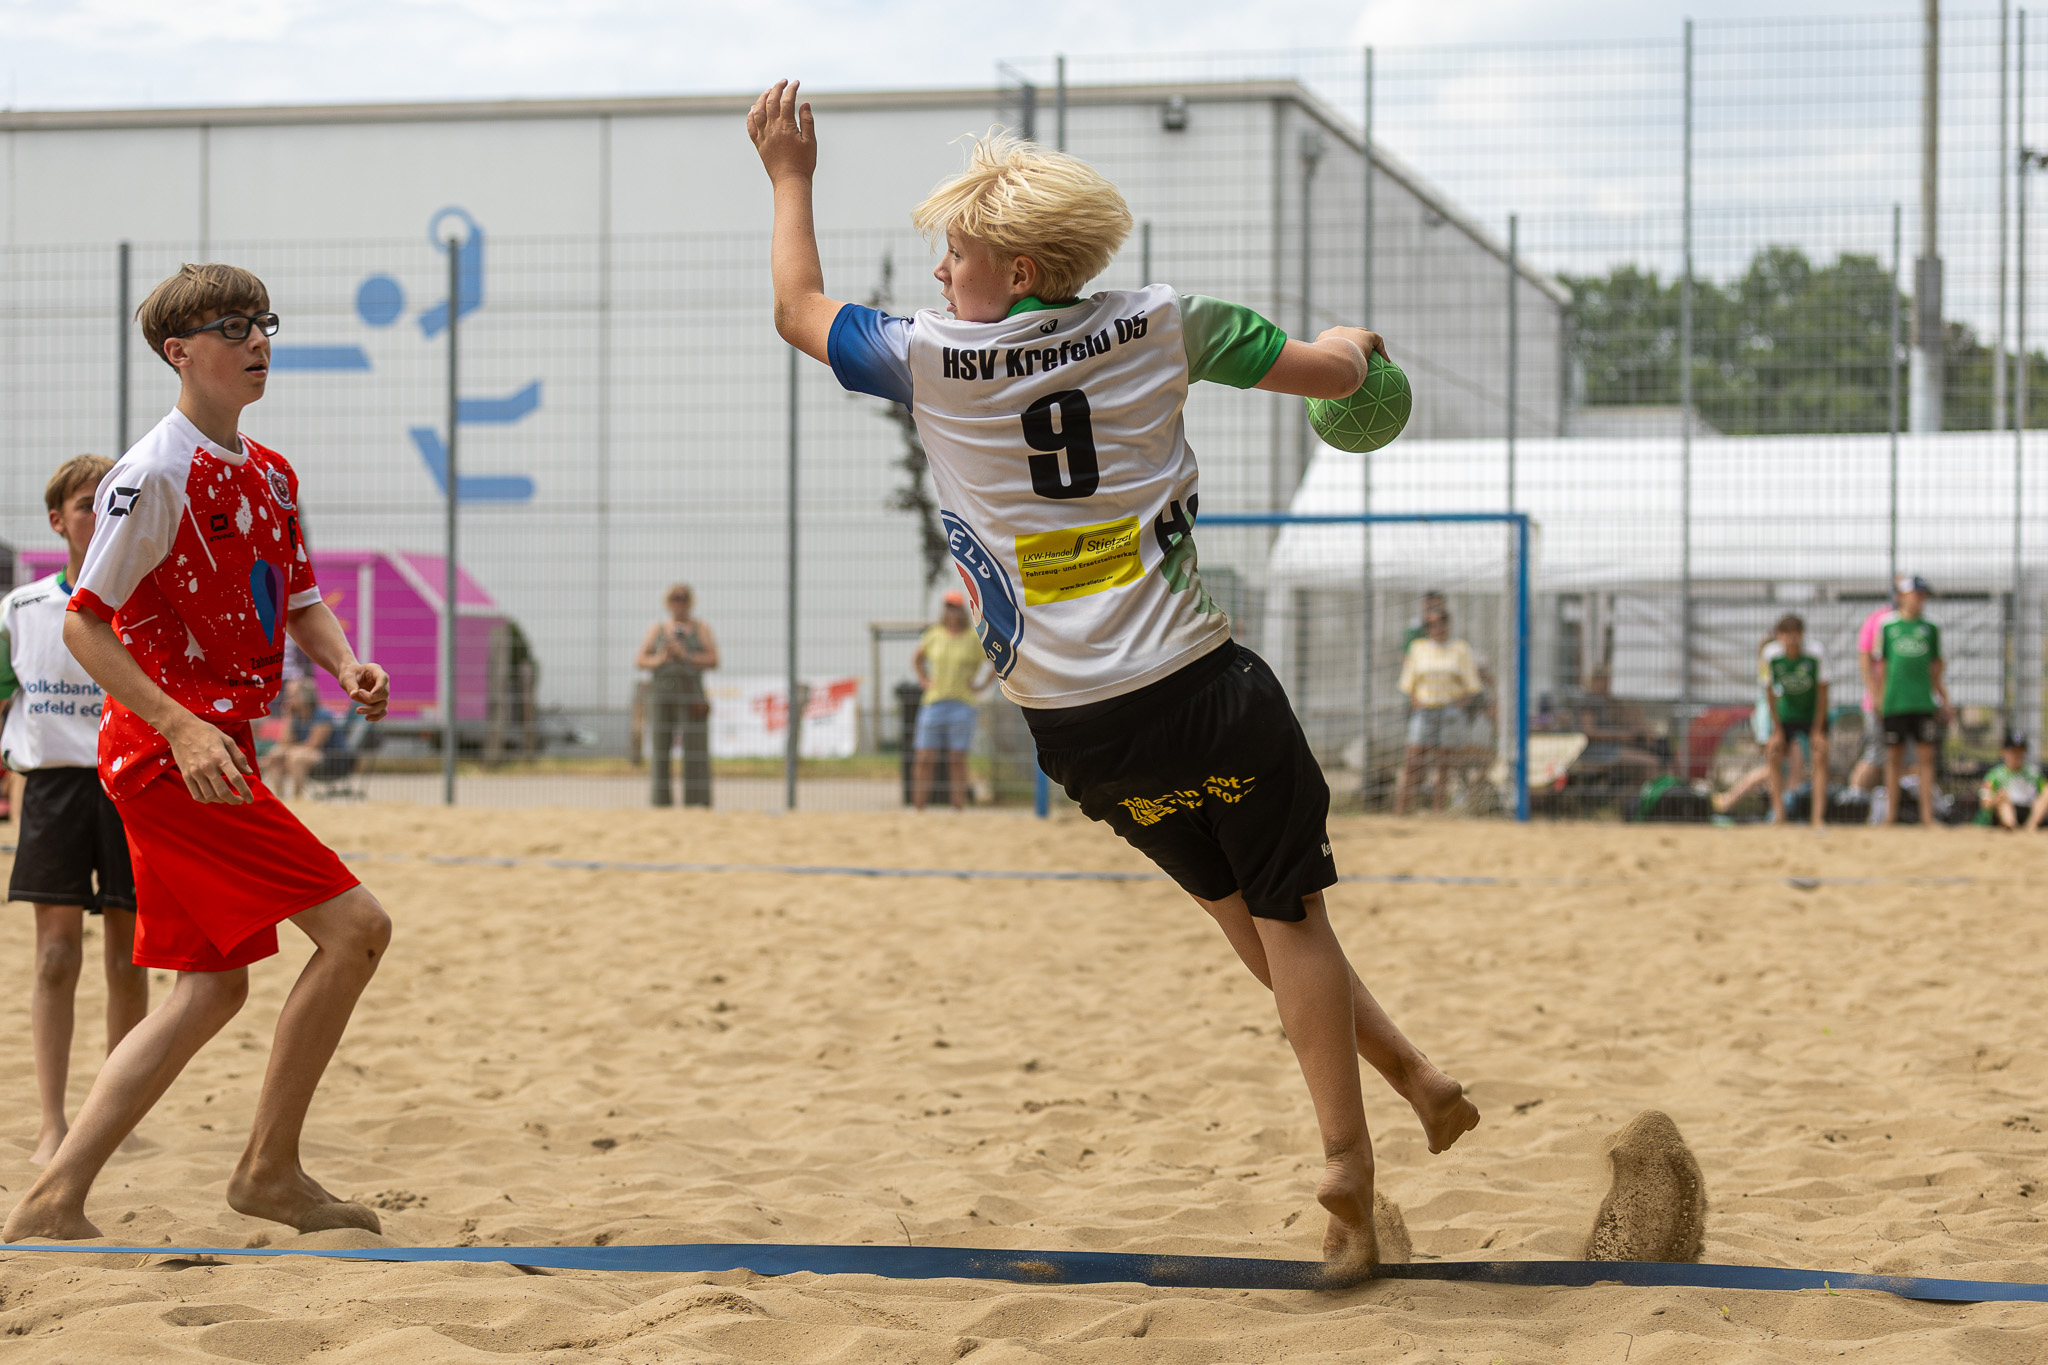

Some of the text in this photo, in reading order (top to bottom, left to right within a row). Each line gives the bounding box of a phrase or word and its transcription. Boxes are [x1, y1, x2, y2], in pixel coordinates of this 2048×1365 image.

[942, 310, 1149, 380] HSV Krefeld 05
[1021, 389, 1100, 499] 9
[1023, 530, 1133, 562] LKW-Handel Stietzel
[1025, 568, 1061, 578] Fahrzeug-
[1062, 564, 1077, 572] und
[1059, 575, 1114, 592] www.lkw-stietzel.de
[80, 702, 103, 717] eG
